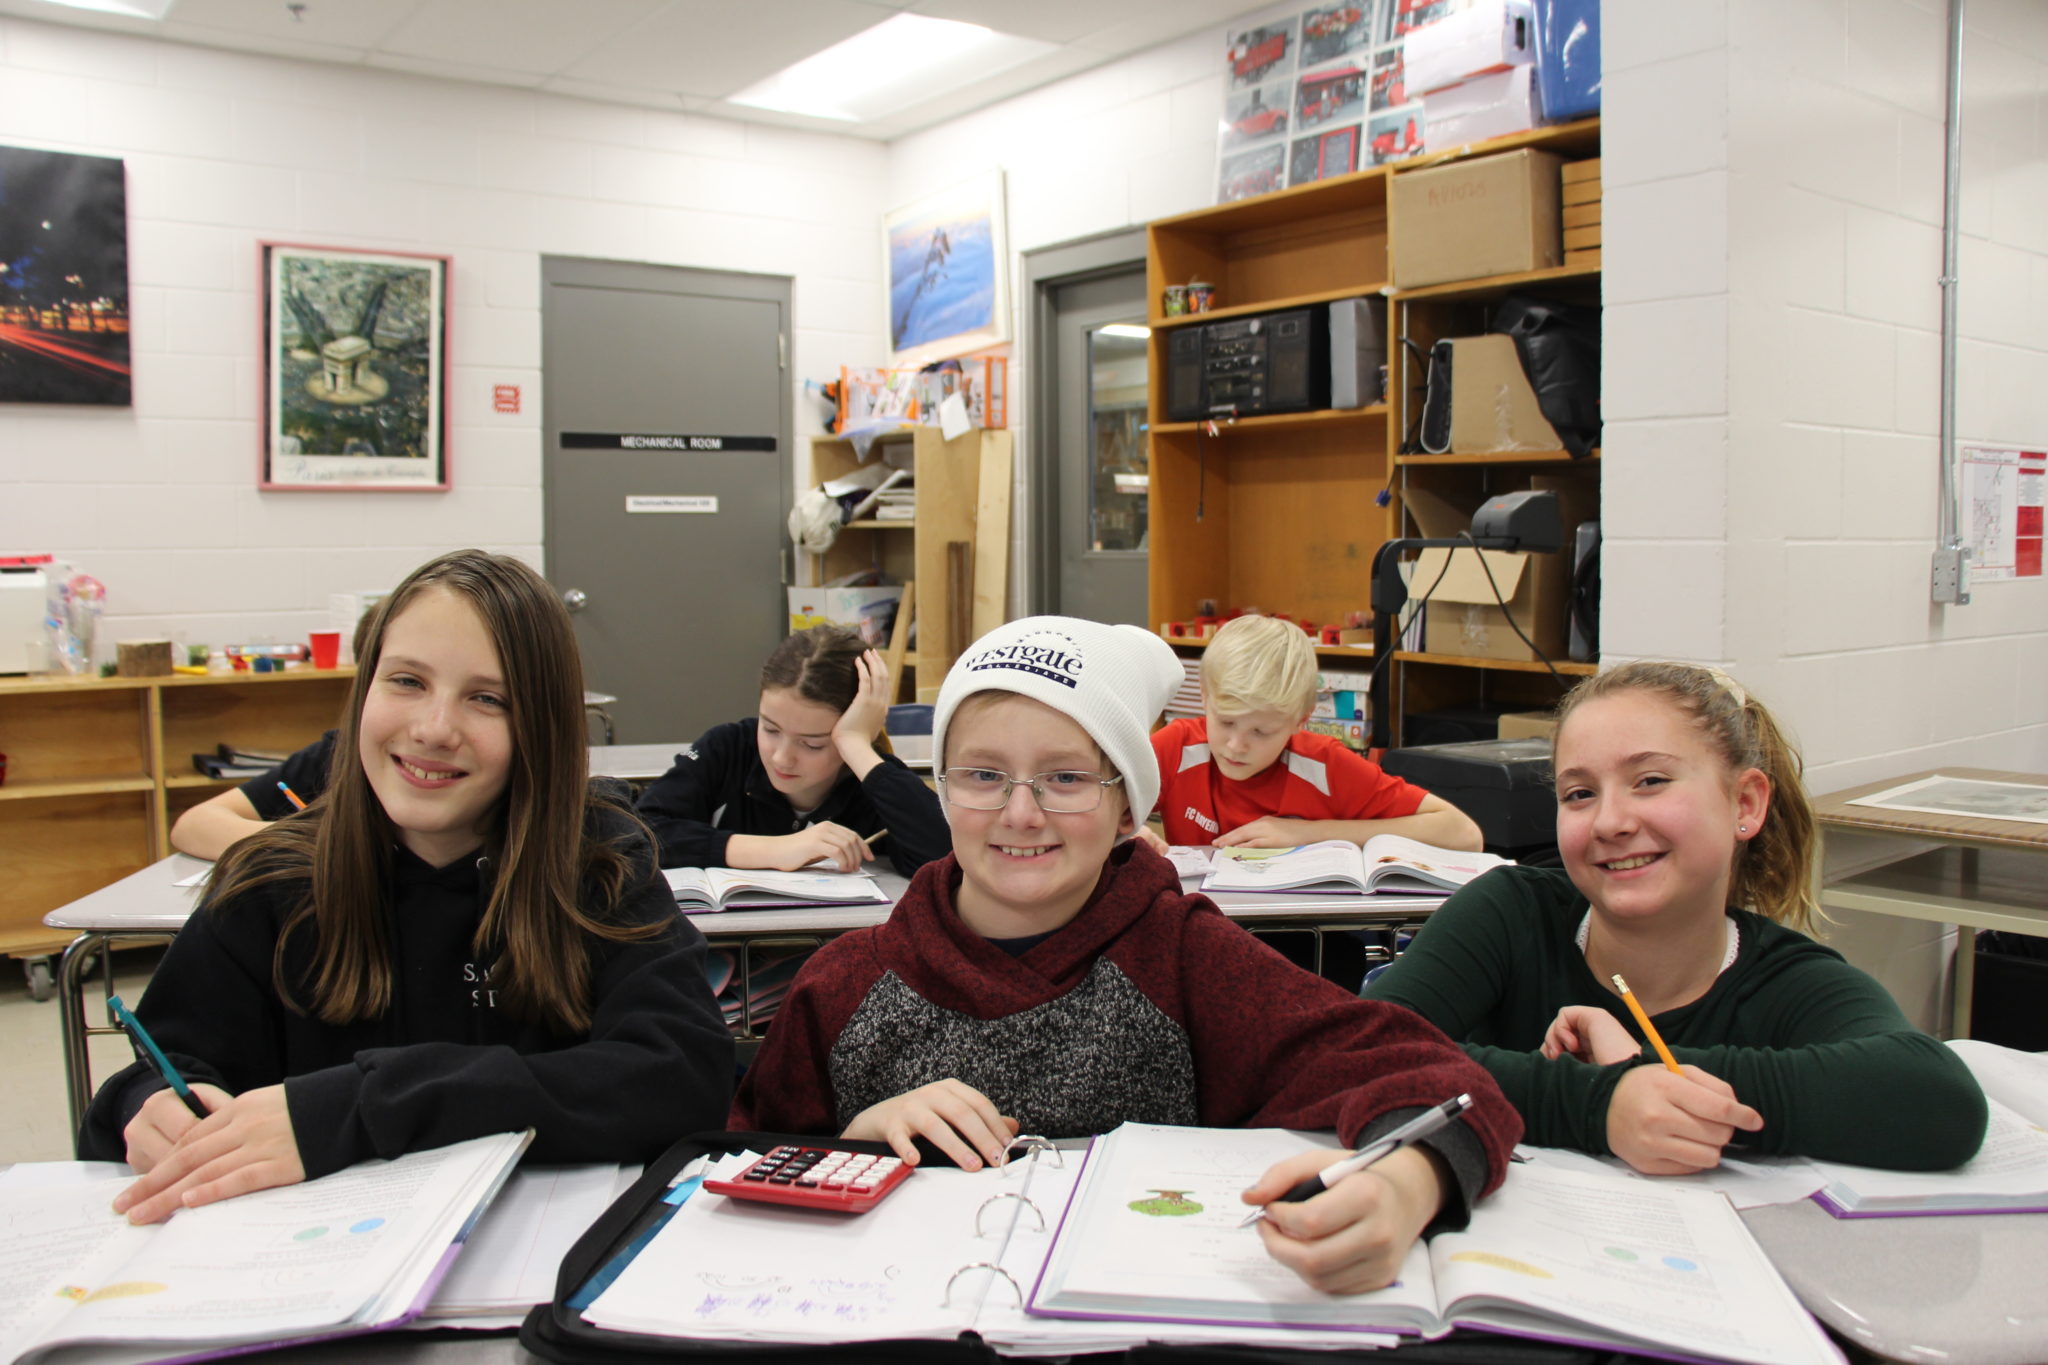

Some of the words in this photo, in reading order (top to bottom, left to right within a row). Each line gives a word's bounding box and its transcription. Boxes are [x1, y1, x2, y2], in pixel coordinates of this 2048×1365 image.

[620, 435, 686, 449] MECHANICAL
[690, 436, 721, 449] ROOM
[977, 663, 1069, 684] COLLEGIATE
[1184, 806, 1197, 820] FC
